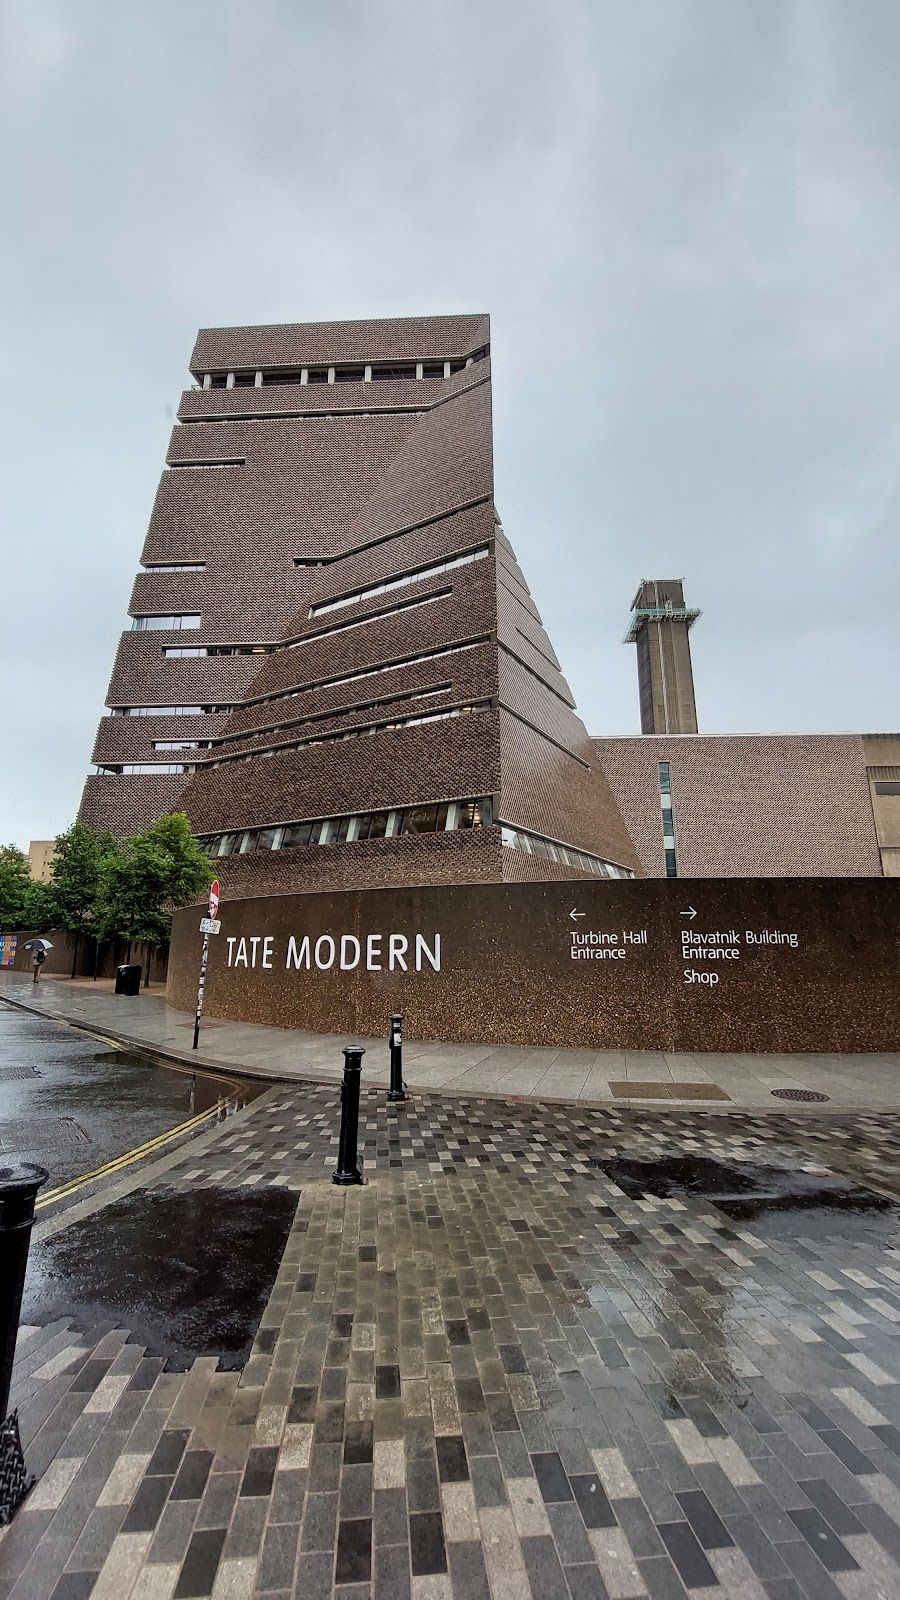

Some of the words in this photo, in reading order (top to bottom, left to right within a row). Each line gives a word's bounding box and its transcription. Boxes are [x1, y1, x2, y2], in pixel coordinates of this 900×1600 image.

[570, 931, 618, 944] Turbine
[623, 930, 648, 944] Hall
[681, 930, 740, 944] Blavatnik
[745, 930, 798, 947] Building
[226, 936, 275, 969] TATE
[286, 933, 441, 972] MODERN
[570, 946, 626, 960] Entrance
[682, 945, 740, 959] Entrance
[684, 969, 719, 986] Shop
